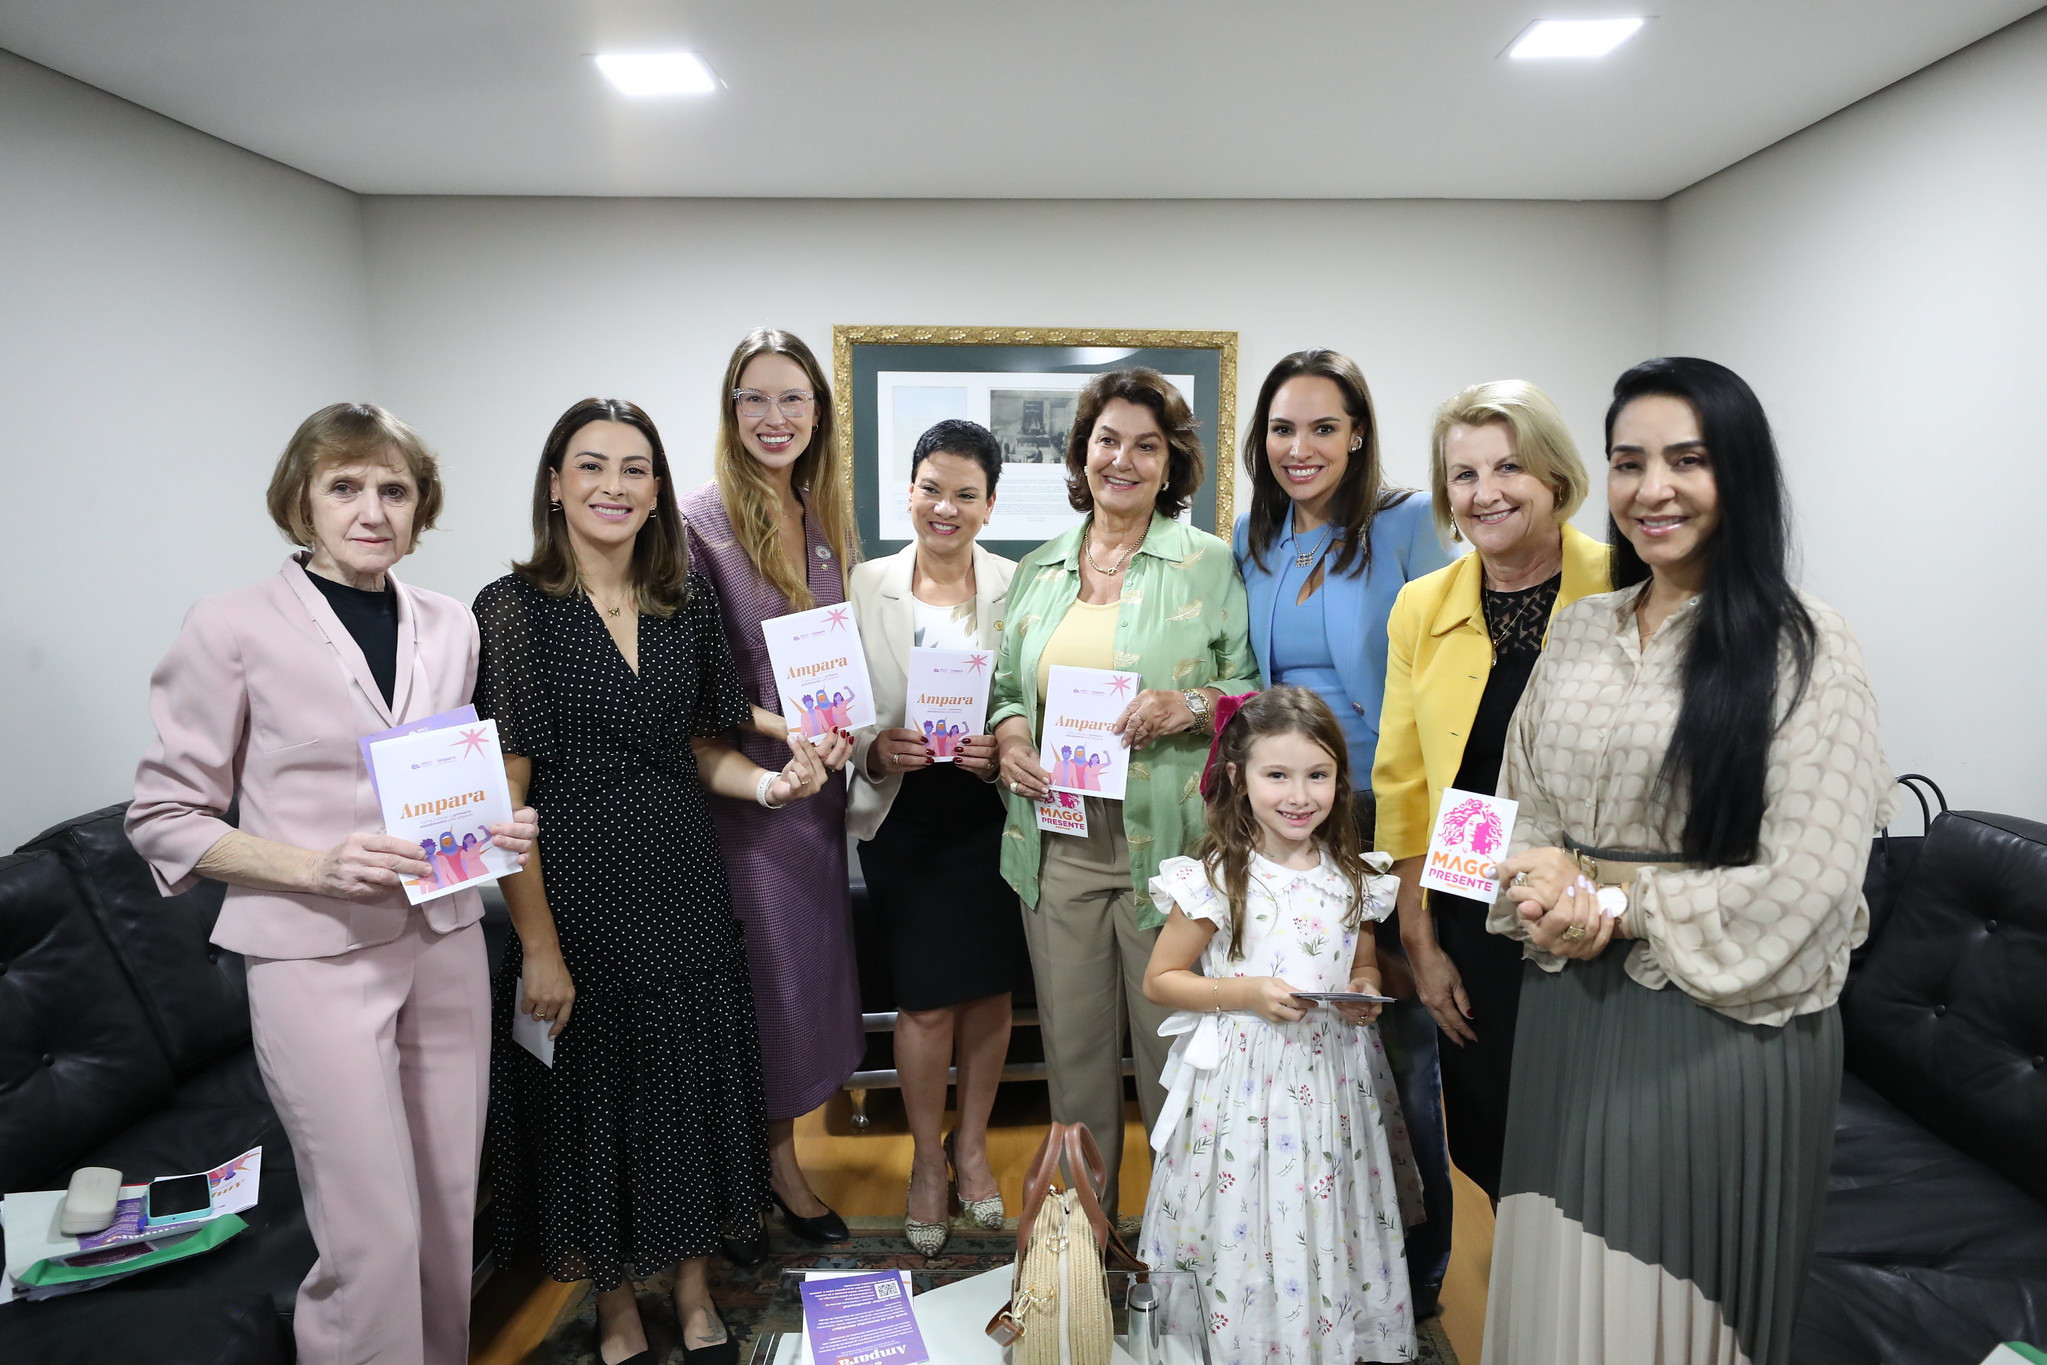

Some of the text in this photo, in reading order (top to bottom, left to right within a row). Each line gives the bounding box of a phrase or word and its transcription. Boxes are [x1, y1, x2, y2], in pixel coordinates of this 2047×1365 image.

[787, 656, 848, 680] Ampara
[917, 692, 974, 707] Ampara
[1055, 715, 1116, 731] Ampara
[400, 789, 486, 819] Ampara
[1041, 816, 1086, 830] PRESENTE
[1428, 867, 1493, 892] PRESENTE
[838, 1345, 906, 1365] Ampara
